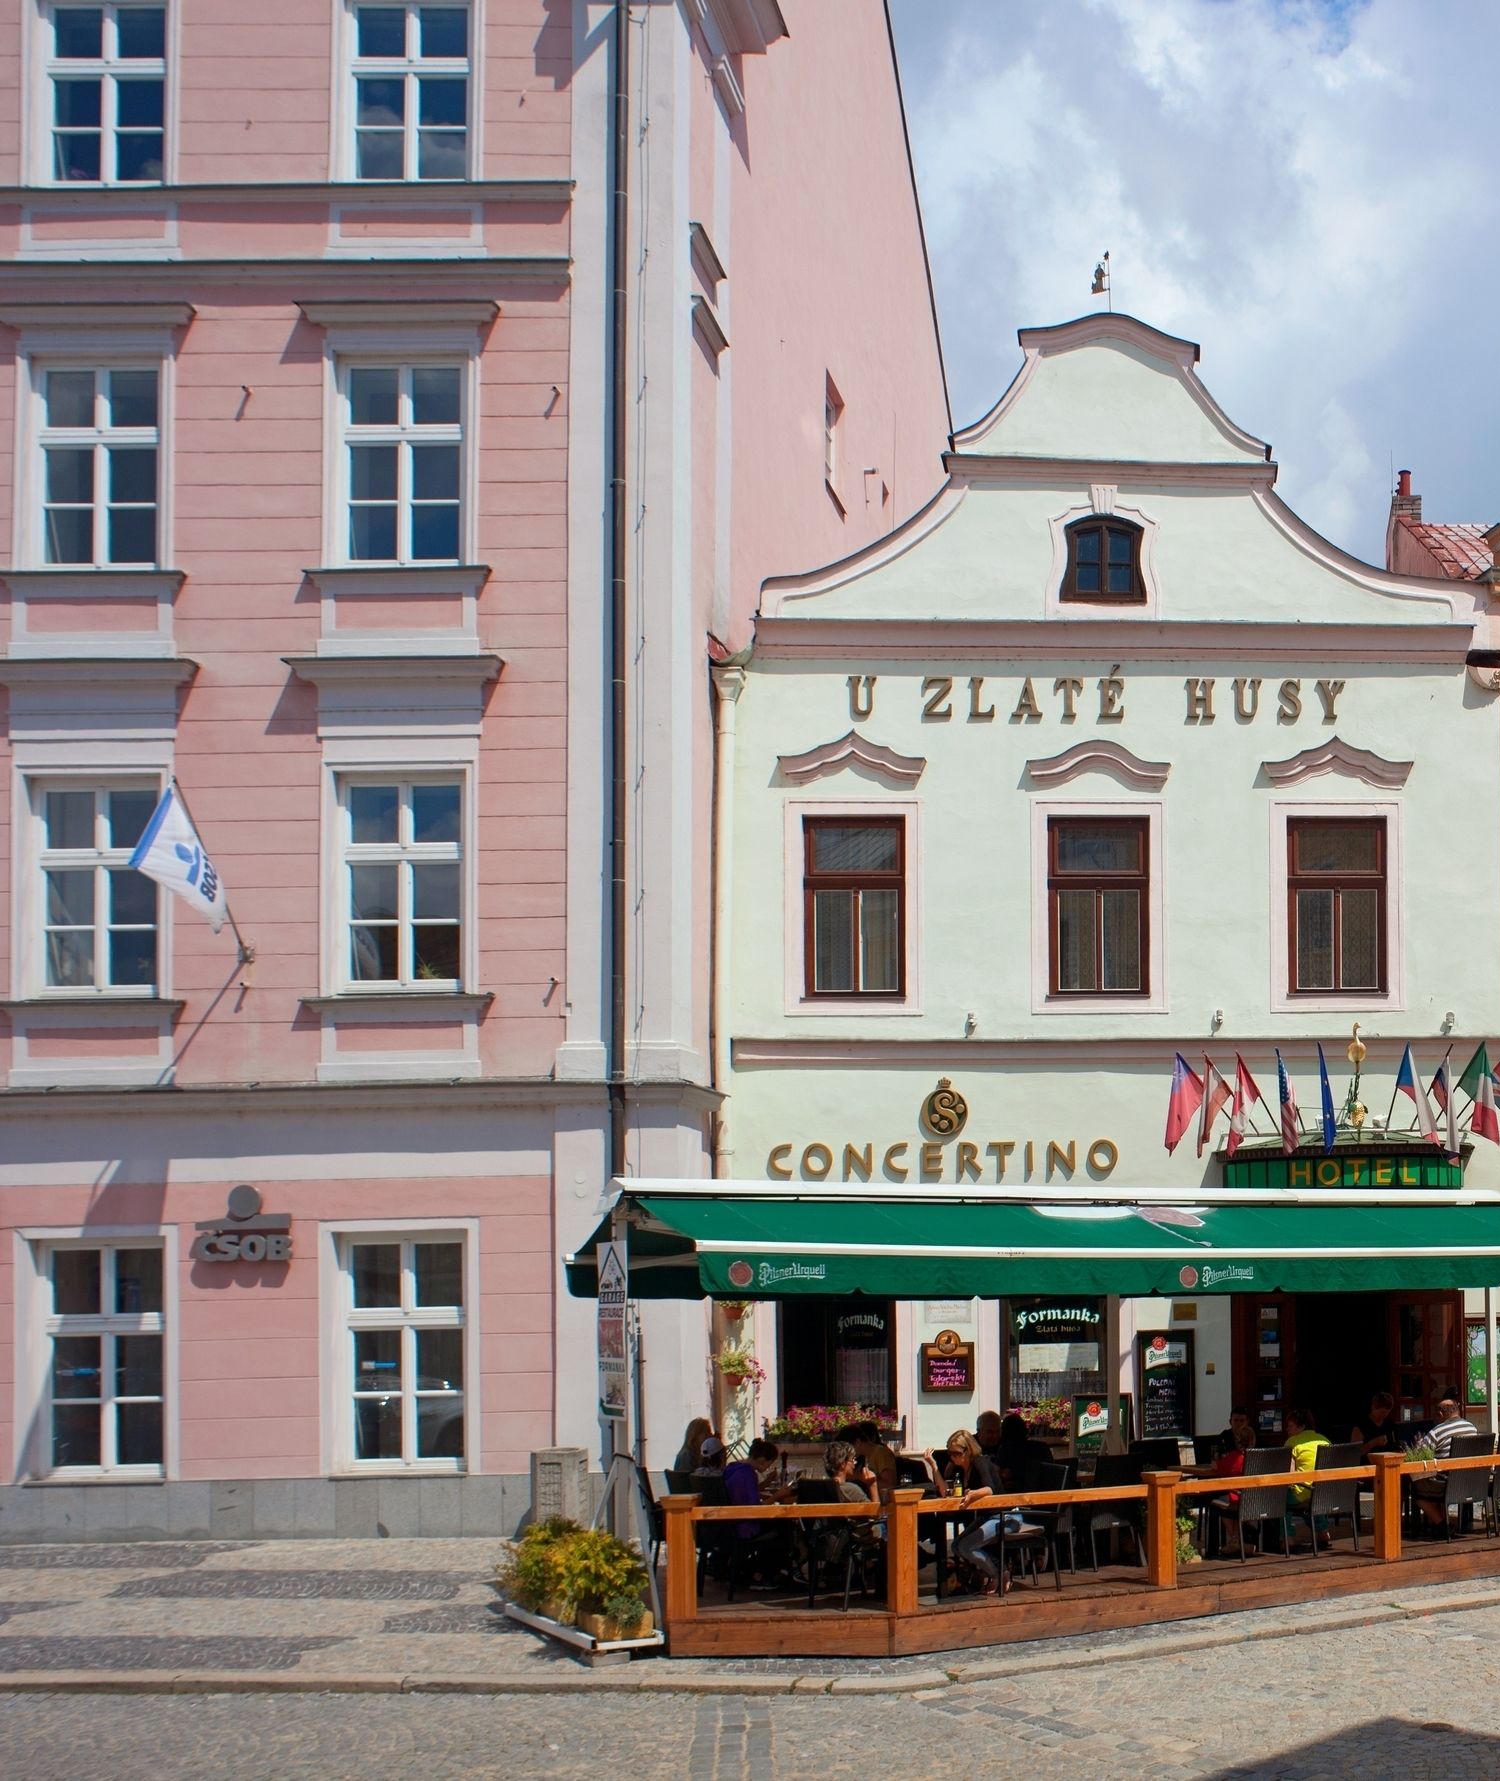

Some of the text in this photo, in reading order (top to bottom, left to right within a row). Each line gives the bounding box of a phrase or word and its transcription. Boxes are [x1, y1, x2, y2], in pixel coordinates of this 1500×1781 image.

[848, 664, 1346, 721] U ZLATÉ HUSY
[766, 1138, 1119, 1177] CONCERTINO
[1290, 1159, 1417, 1186] HOTEL
[191, 1231, 293, 1262] ČSOB
[759, 1261, 826, 1287] Pilsner Urquell
[1202, 1264, 1255, 1288] Pilsner Urquell
[600, 1292, 625, 1303] GARAGE
[837, 1313, 885, 1334] Formanka
[1015, 1307, 1101, 1330] Formanka
[599, 1361, 625, 1372] FORMANKA
